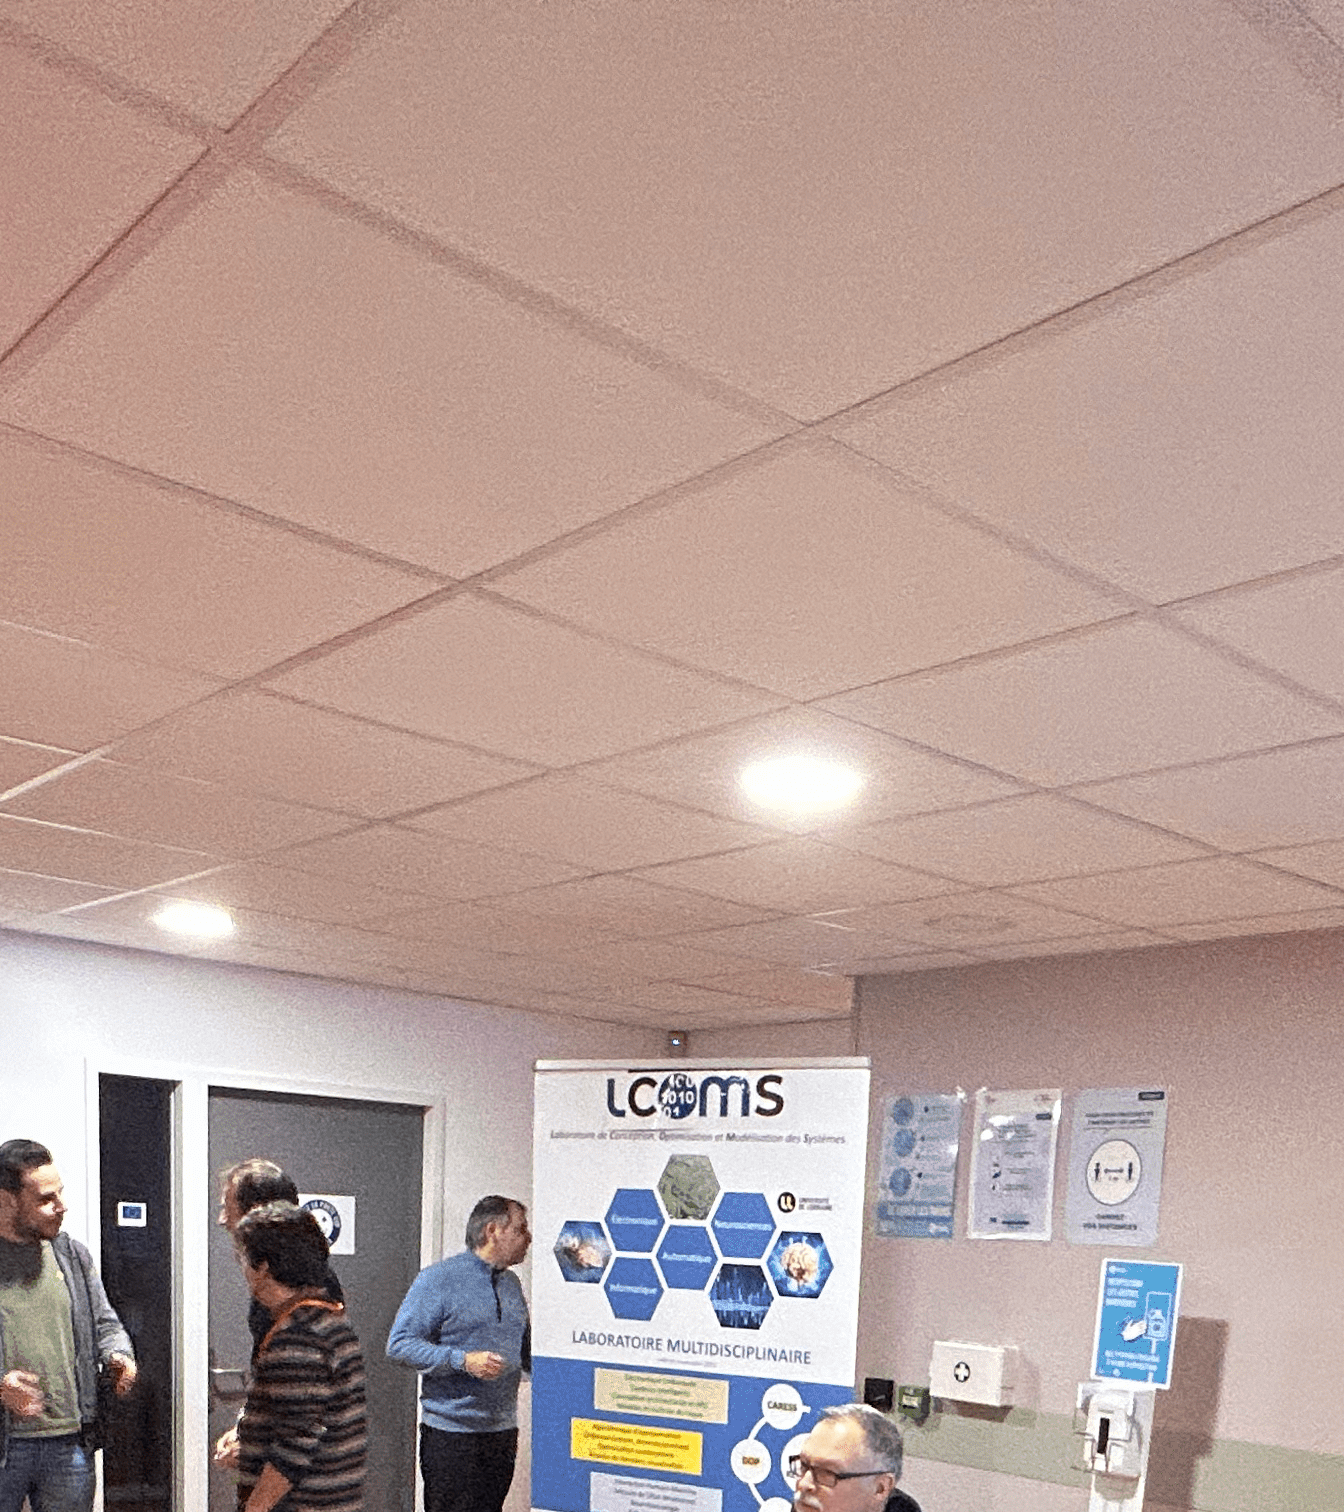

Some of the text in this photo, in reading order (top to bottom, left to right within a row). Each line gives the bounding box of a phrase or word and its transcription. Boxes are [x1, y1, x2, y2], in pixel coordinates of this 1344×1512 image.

[572, 1330, 663, 1351] LABORATOIRE
[666, 1338, 812, 1365] MULTIDISCIPLINAIRE
[767, 1400, 798, 1412] CARESS
